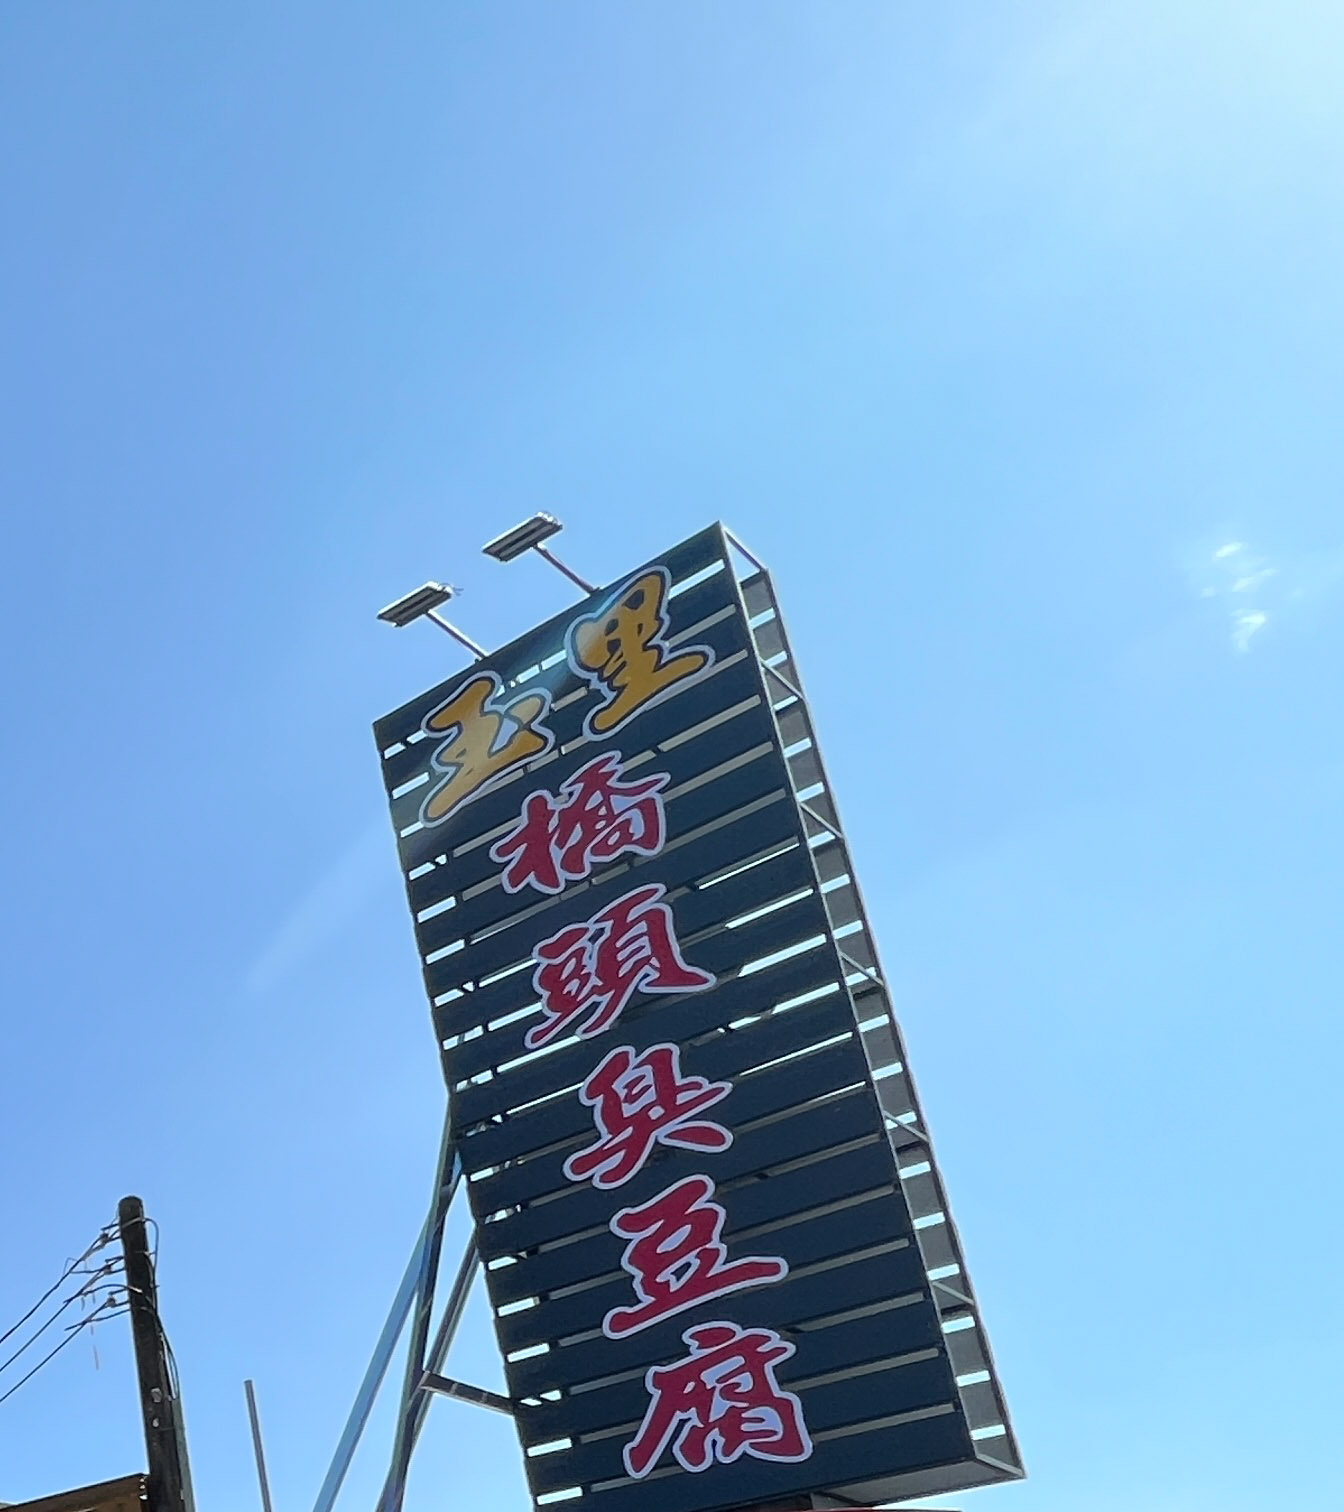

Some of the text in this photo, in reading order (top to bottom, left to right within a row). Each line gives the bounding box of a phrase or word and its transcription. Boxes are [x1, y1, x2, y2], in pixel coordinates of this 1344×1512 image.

[418, 564, 715, 828] 玉里
[491, 751, 812, 1479] 橋頭臭豆腐
